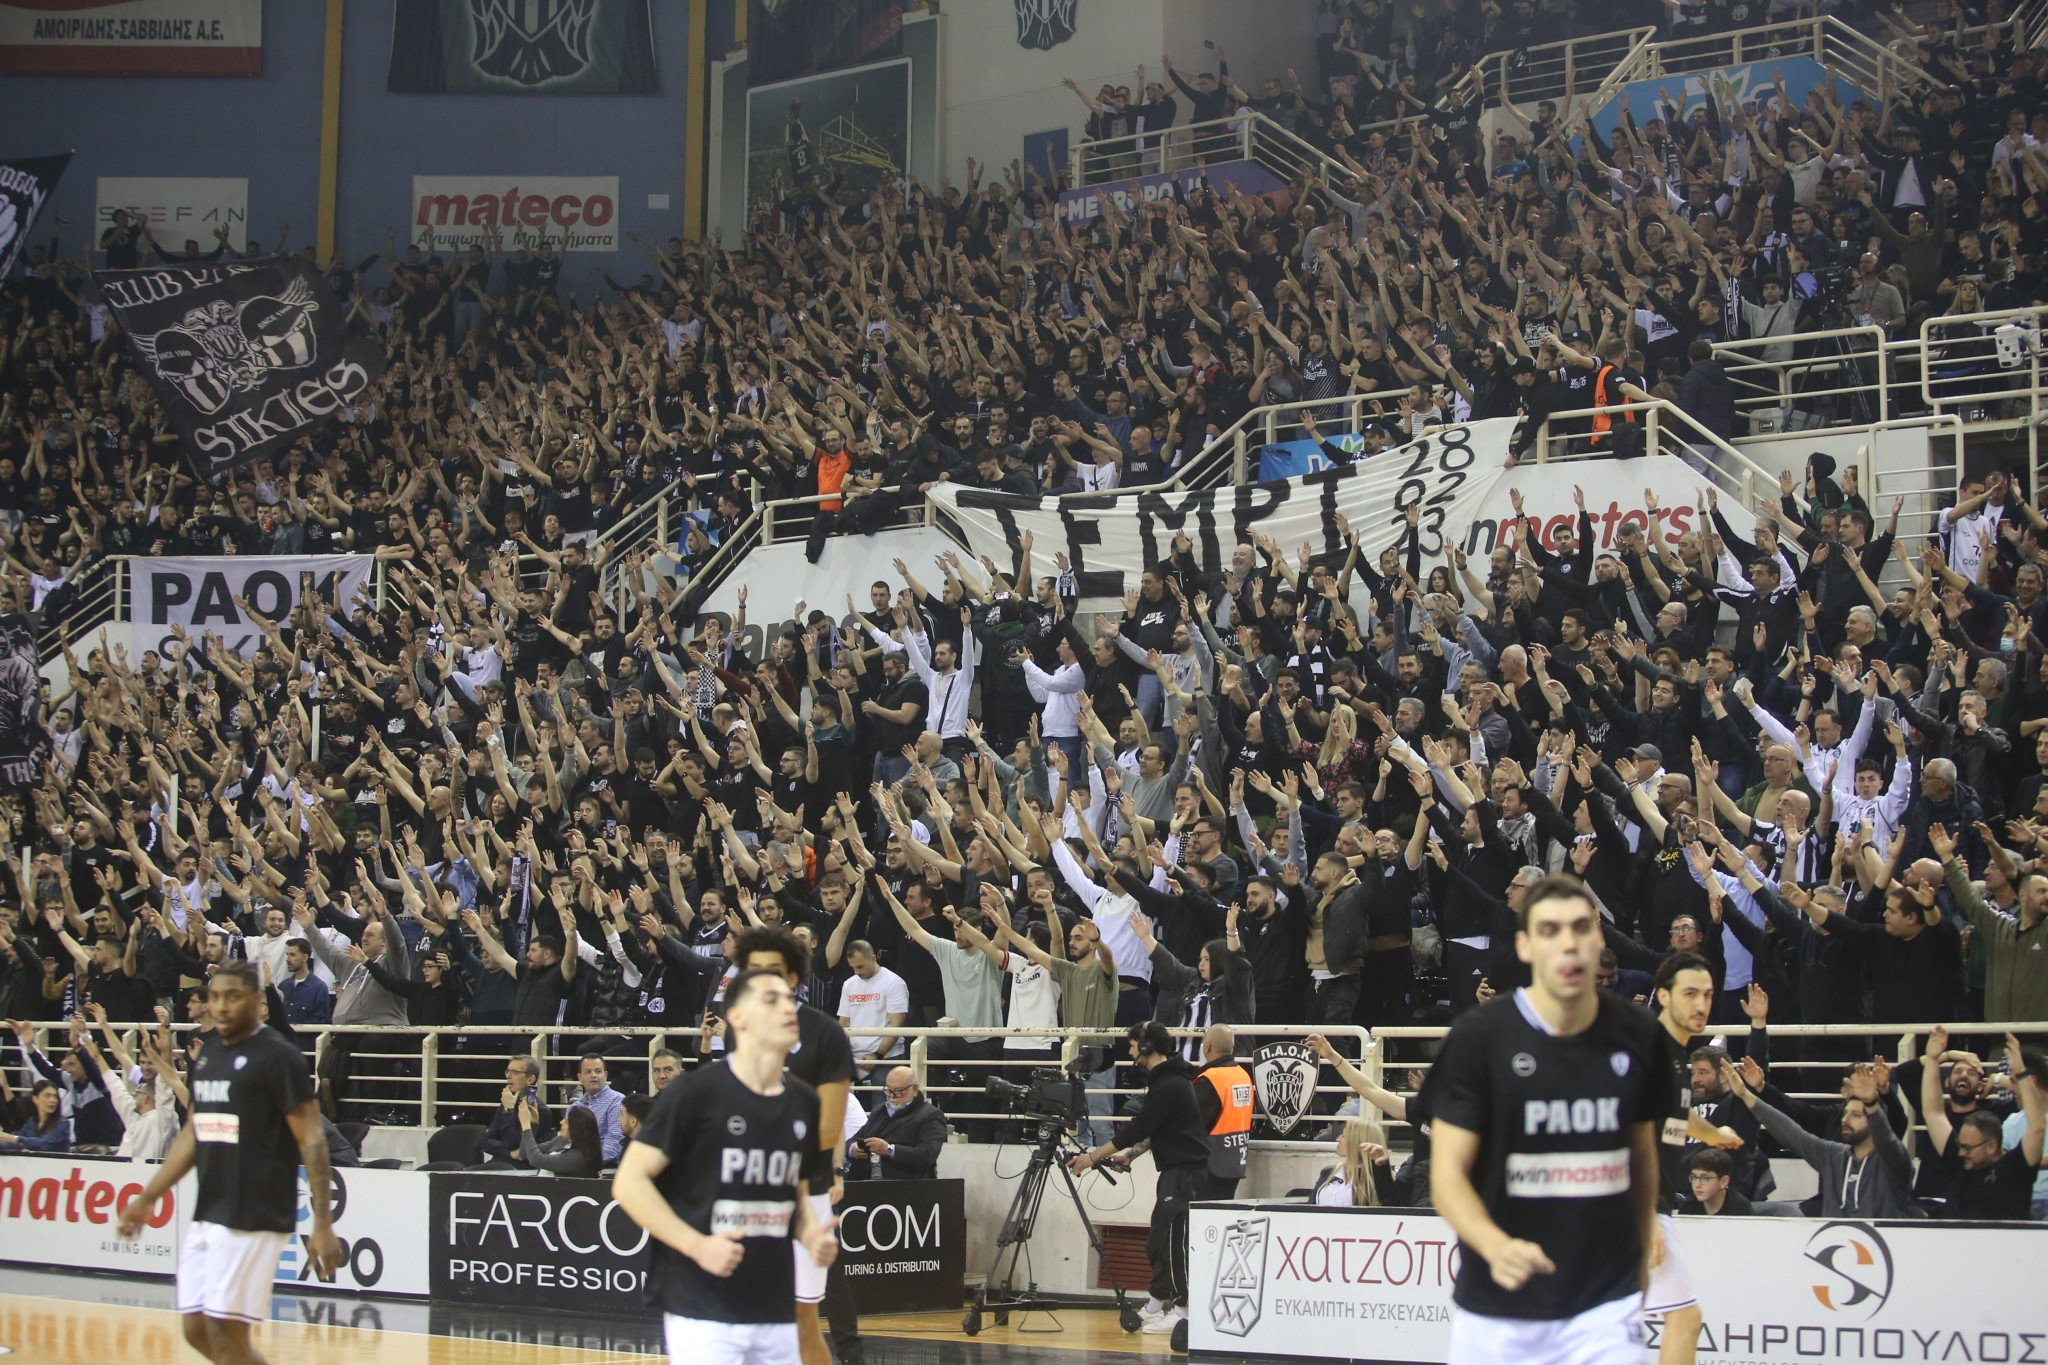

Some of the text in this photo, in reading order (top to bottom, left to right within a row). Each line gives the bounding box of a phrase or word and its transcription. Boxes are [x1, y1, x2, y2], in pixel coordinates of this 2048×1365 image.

[416, 187, 614, 227] mateco
[1399, 427, 1475, 480] 28
[1394, 472, 1467, 512] 02
[1524, 1097, 1621, 1135] PAOK
[101, 1241, 172, 1257] AIMING HIGH
[876, 1262, 883, 1274] &
[884, 1260, 940, 1275] DISTRIBUTION
[1275, 1299, 1451, 1323] ΕΥΚΑΜΠΤΗ ΣΥΣΚΕΥΑΣΙΑ
[1644, 1319, 2047, 1364] ΣΔΗΡΟΠΟΥΛΟΣ
